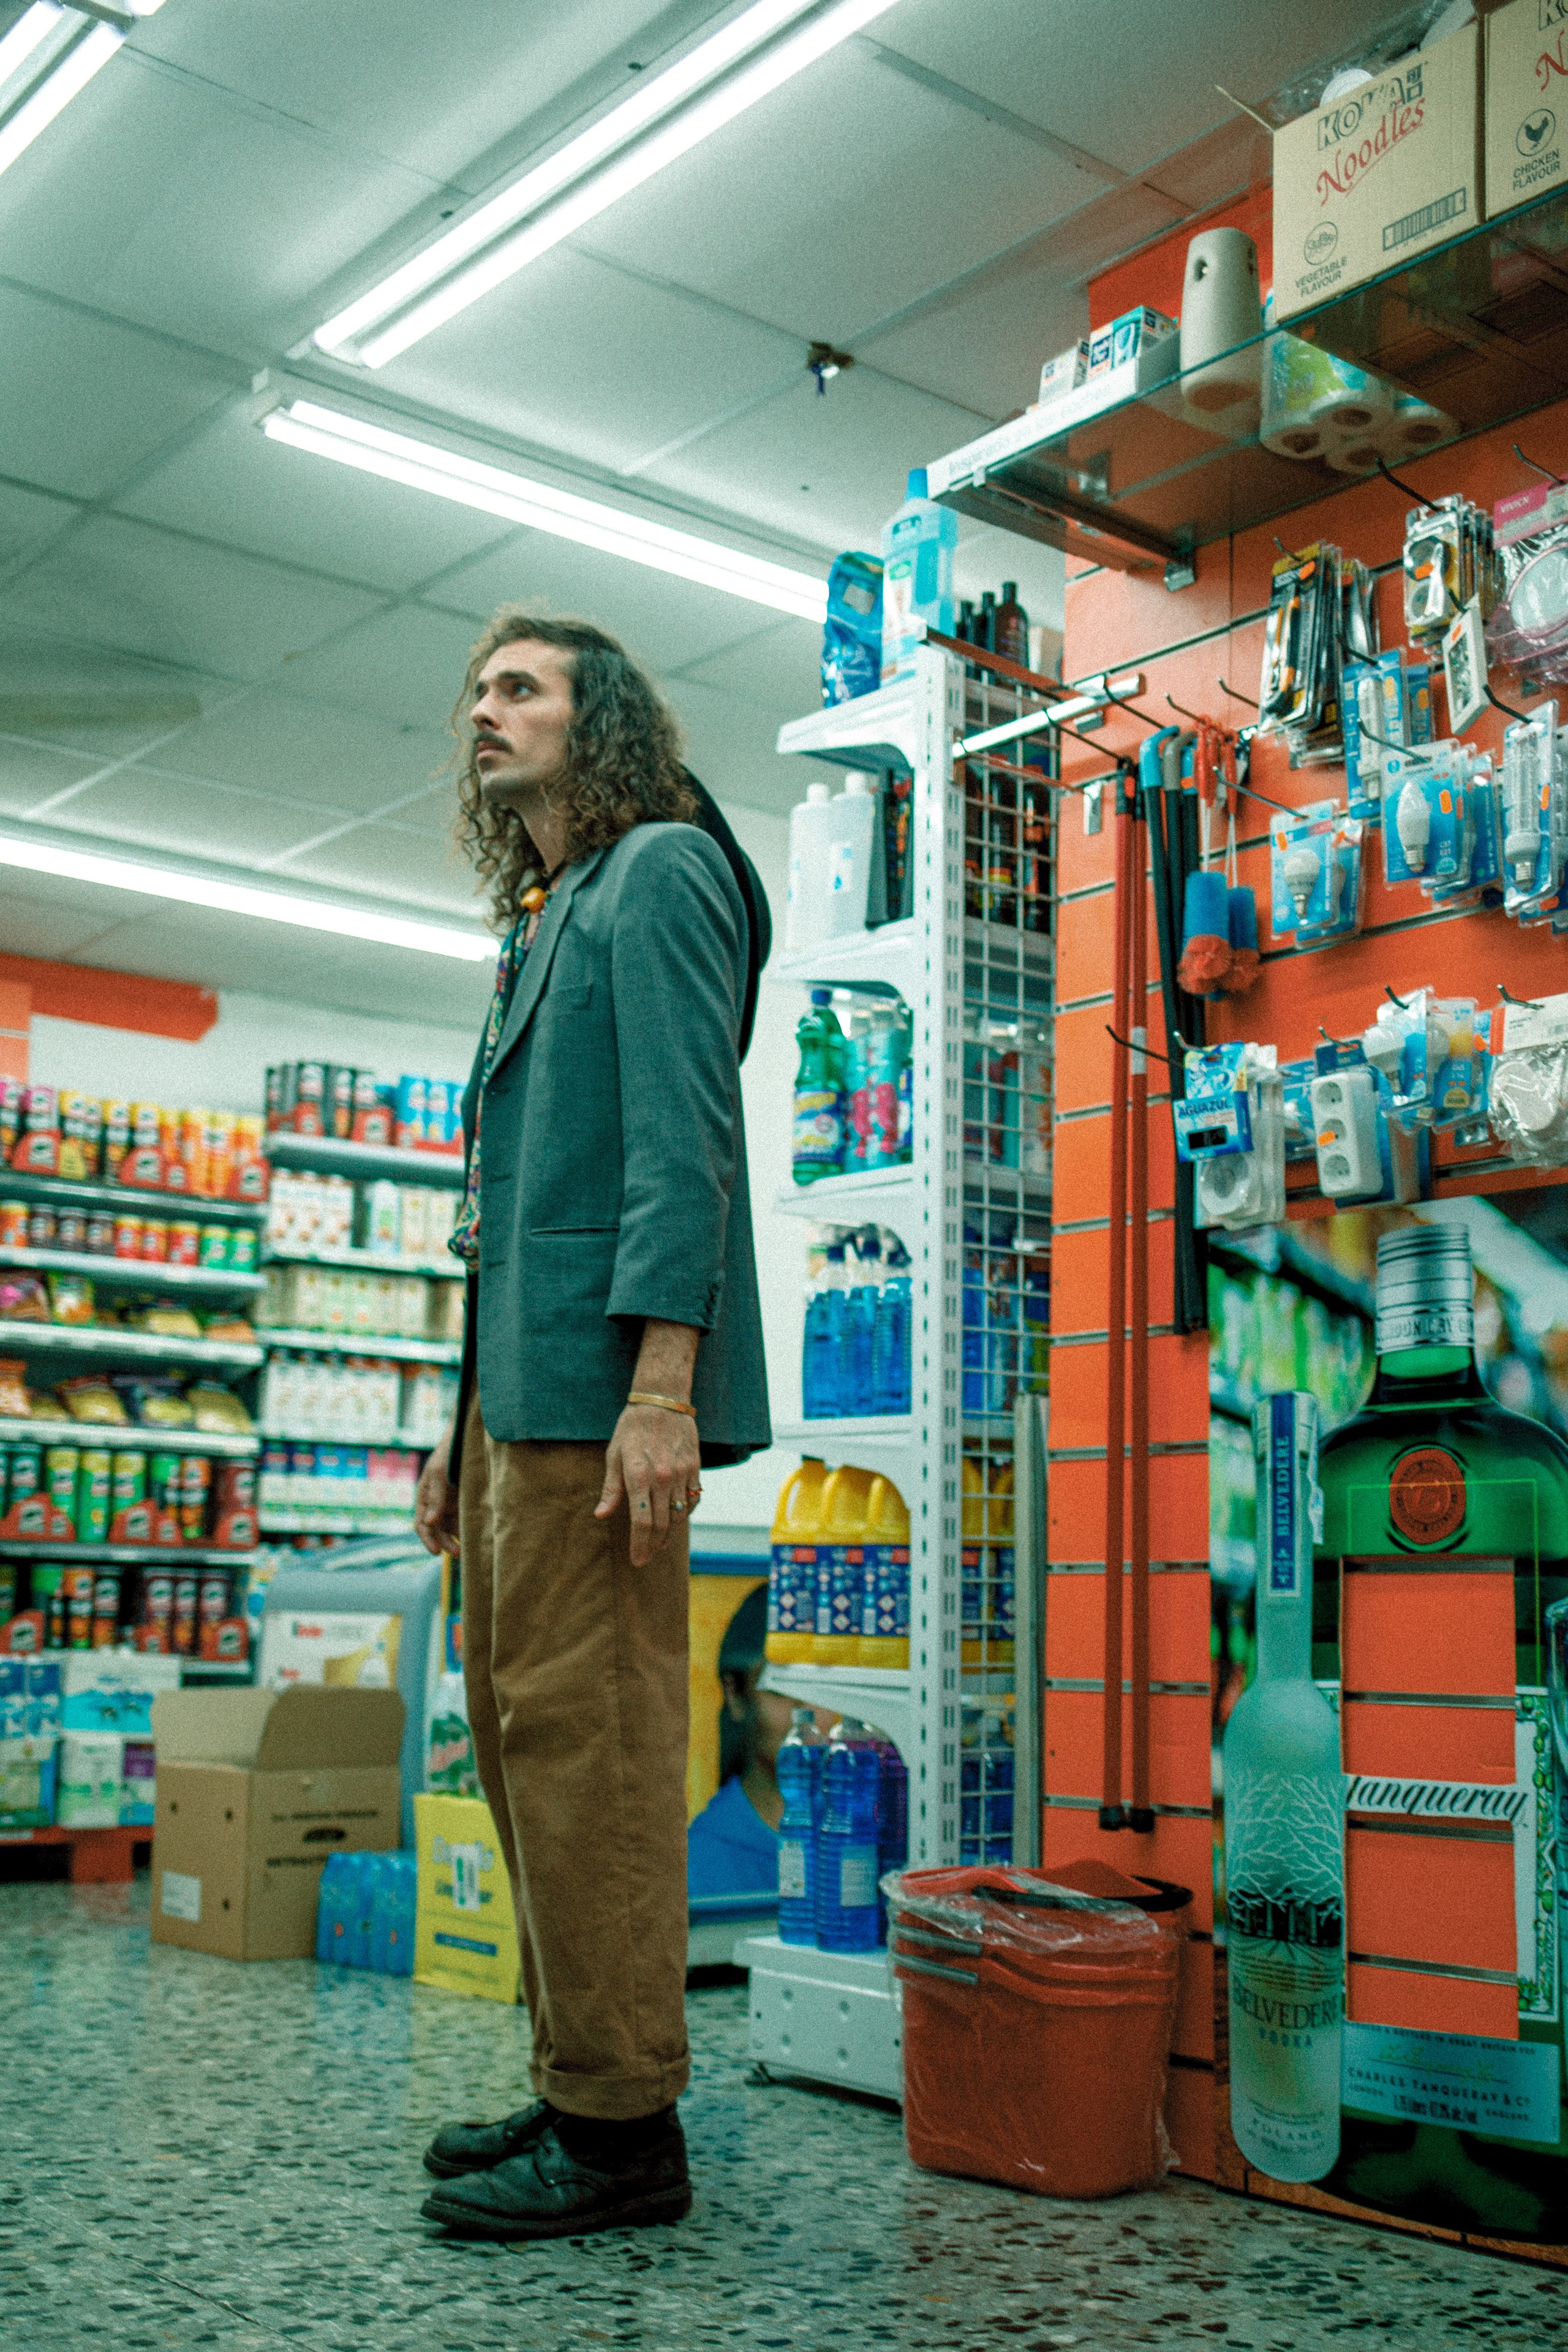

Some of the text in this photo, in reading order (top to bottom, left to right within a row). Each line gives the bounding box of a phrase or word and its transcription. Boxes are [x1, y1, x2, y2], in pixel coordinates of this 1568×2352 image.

[1317, 97, 1426, 207] Noodles
[1513, 148, 1559, 179] CHICKEN
[1512, 160, 1561, 191] FLAVOUR
[1295, 255, 1348, 288] VEGETABLE
[1300, 270, 1342, 298] FLAVOUR
[1178, 1099, 1232, 1119] AGUAZUL
[1275, 1434, 1291, 1537] BELVEDERE
[1257, 2027, 1313, 2049] VODKA
[1348, 2067, 1405, 2088] CHARLES
[1412, 2079, 1498, 2103] TANQUERAY
